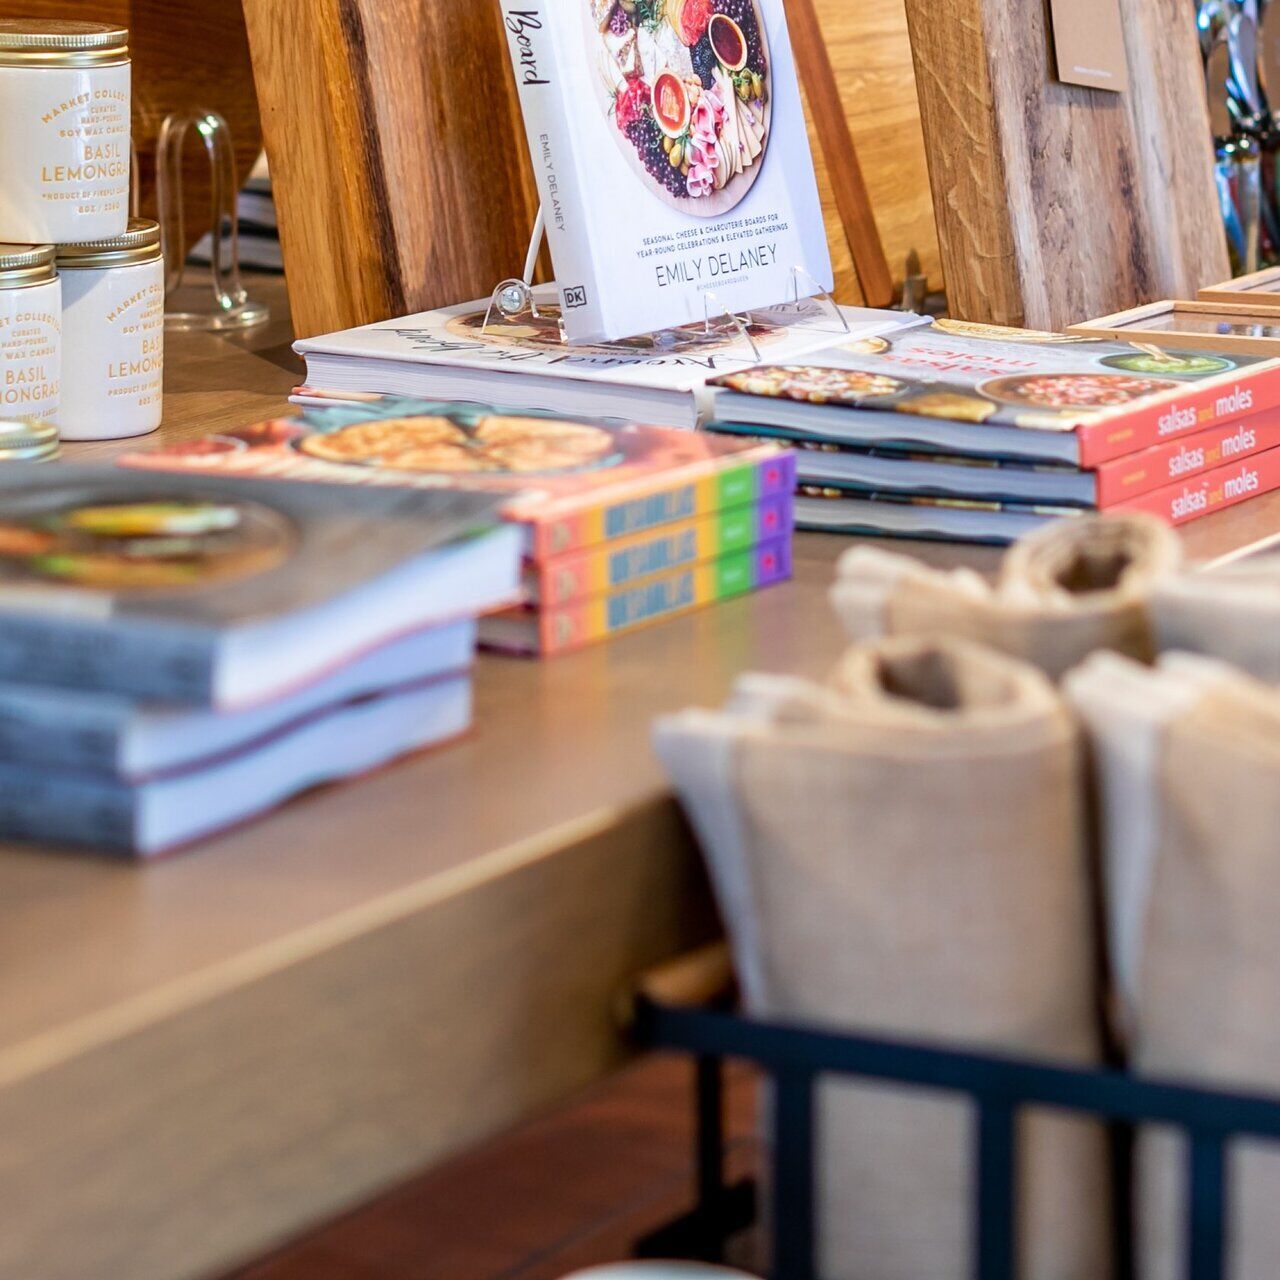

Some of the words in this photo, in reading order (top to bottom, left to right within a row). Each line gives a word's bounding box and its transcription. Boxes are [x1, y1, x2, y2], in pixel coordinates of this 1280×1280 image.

[506, 11, 550, 85] Board
[41, 93, 90, 123] MARKET
[59, 129, 81, 137] SOY
[84, 127, 103, 136] WAX
[84, 143, 121, 161] BASIL
[539, 133, 553, 171] EMILY
[547, 175, 565, 231] DELANEY
[636, 245, 676, 259] YEAR-ROUND
[677, 236, 719, 251] CELEBRATIONS
[726, 229, 753, 242] ELEVATED
[754, 222, 789, 236] GATHERINGS
[642, 234, 674, 246] SEASONAL
[676, 229, 698, 240] CHEESE
[705, 220, 743, 234] CHARCUTERIE
[744, 216, 767, 227] BOARDS
[768, 213, 778, 222] FOR
[655, 258, 702, 287] EMILY
[708, 243, 777, 276] DELANEY
[5, 351, 26, 360] WAX
[5, 365, 47, 385] BASIL
[1158, 405, 1197, 436] salsas
[1215, 385, 1253, 417] moles
[1168, 446, 1205, 477] salsas
[1221, 425, 1256, 458] moles
[1171, 488, 1207, 519] salsas
[1224, 467, 1259, 499] moles
